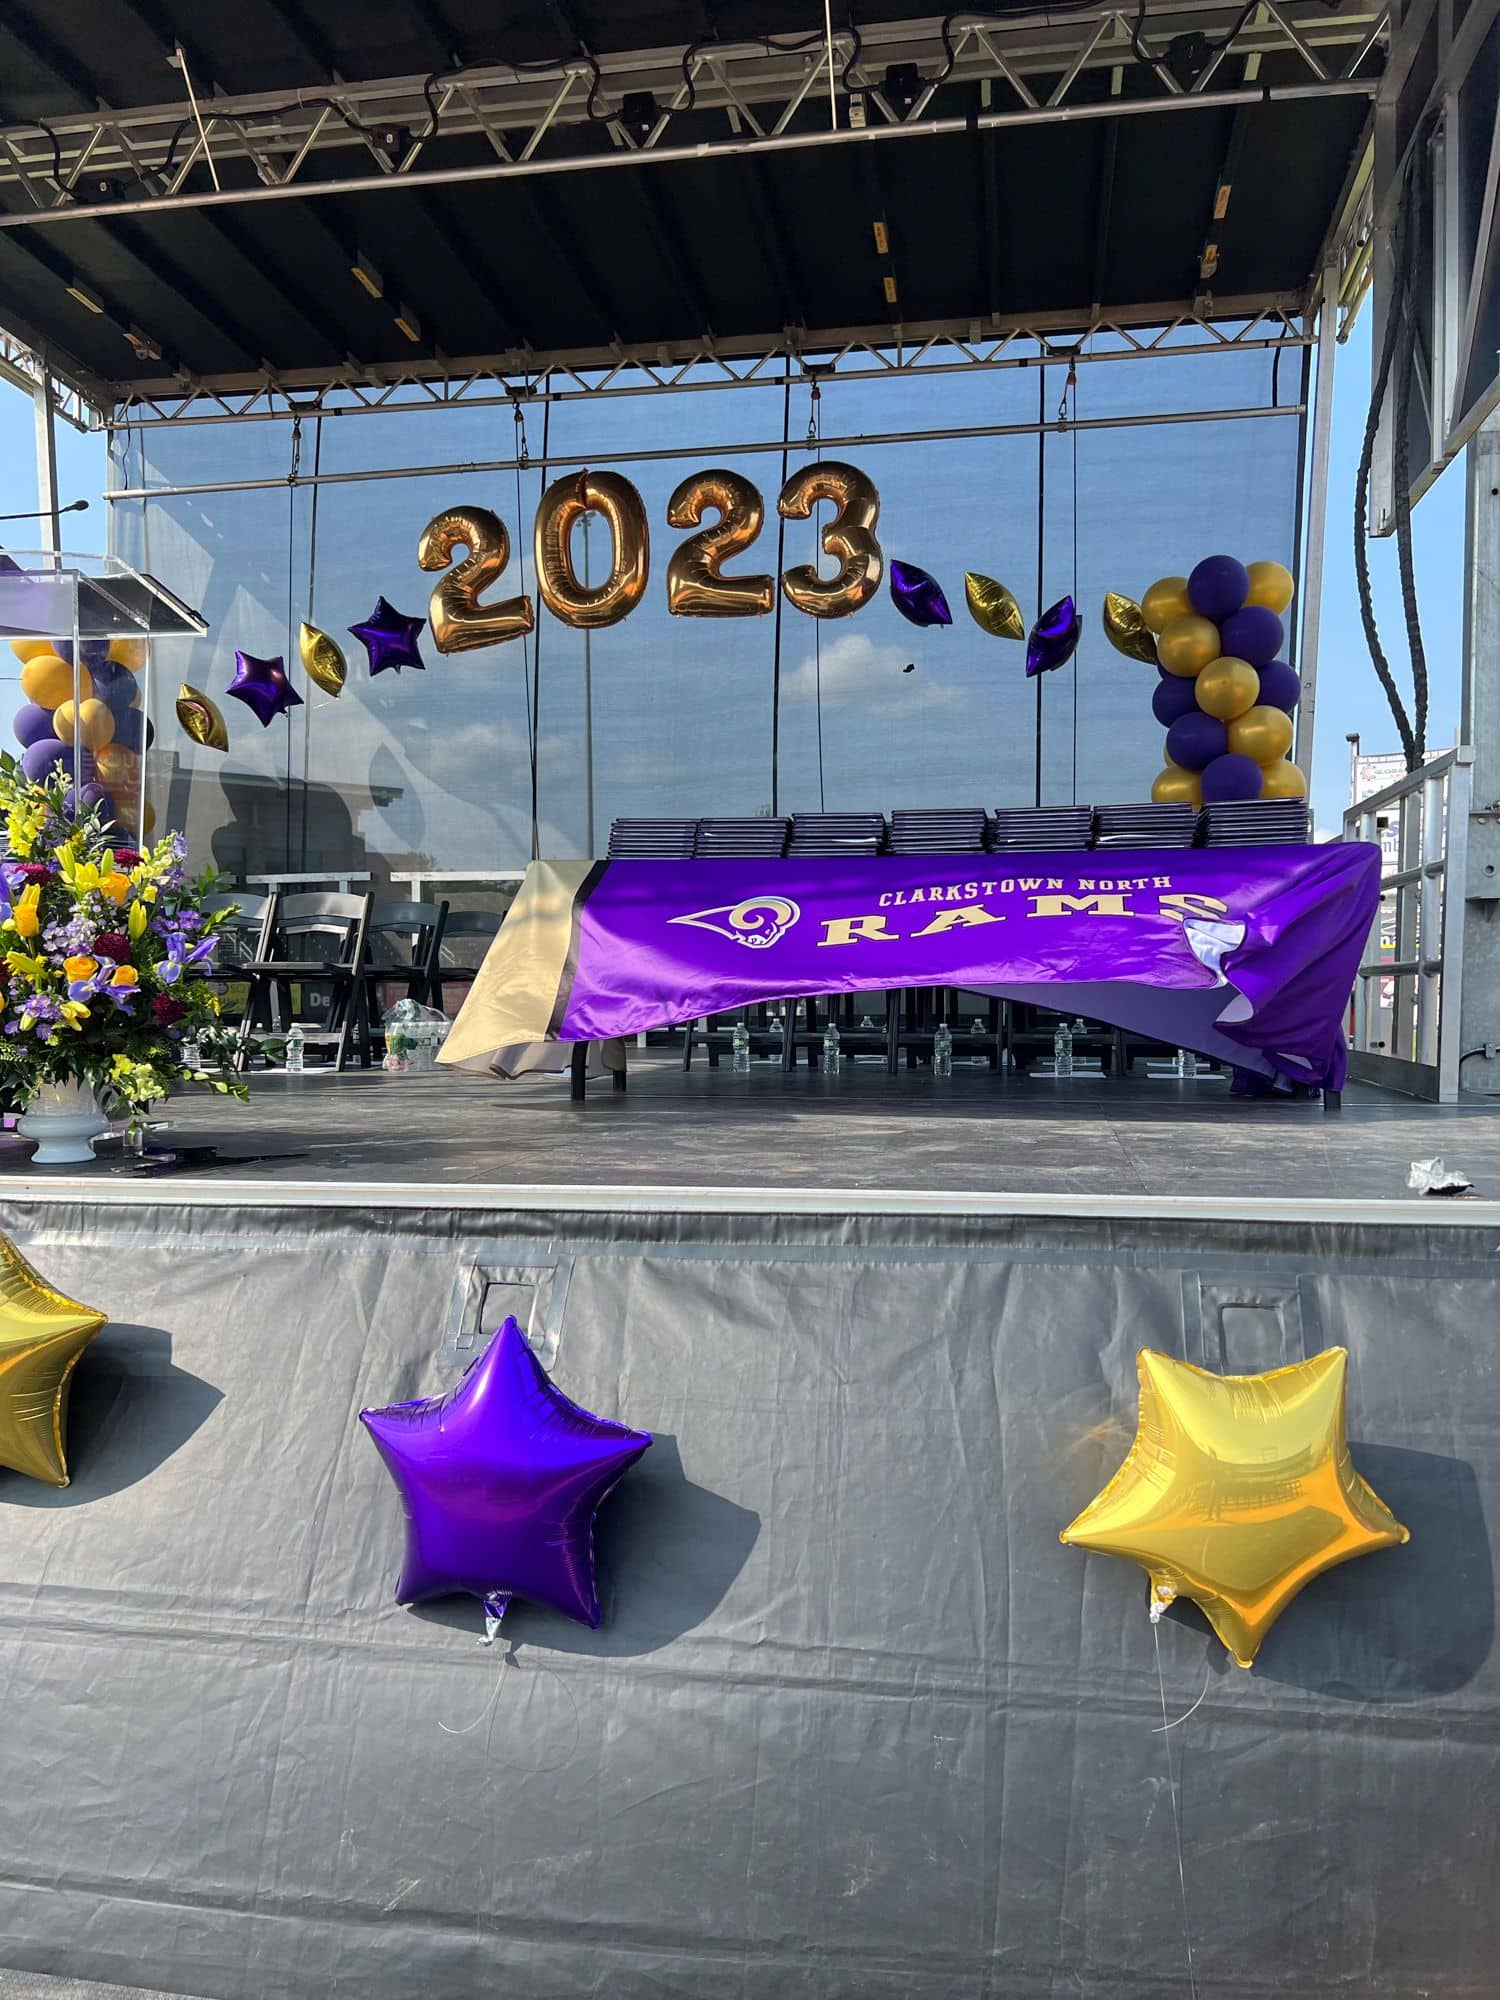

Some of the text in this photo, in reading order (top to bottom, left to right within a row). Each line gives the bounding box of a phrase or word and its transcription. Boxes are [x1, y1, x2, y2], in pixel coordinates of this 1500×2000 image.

[417, 460, 884, 655] 2023
[878, 875, 1173, 908] CLARKSTOWN NORTH
[815, 893, 1229, 948] RAMS
